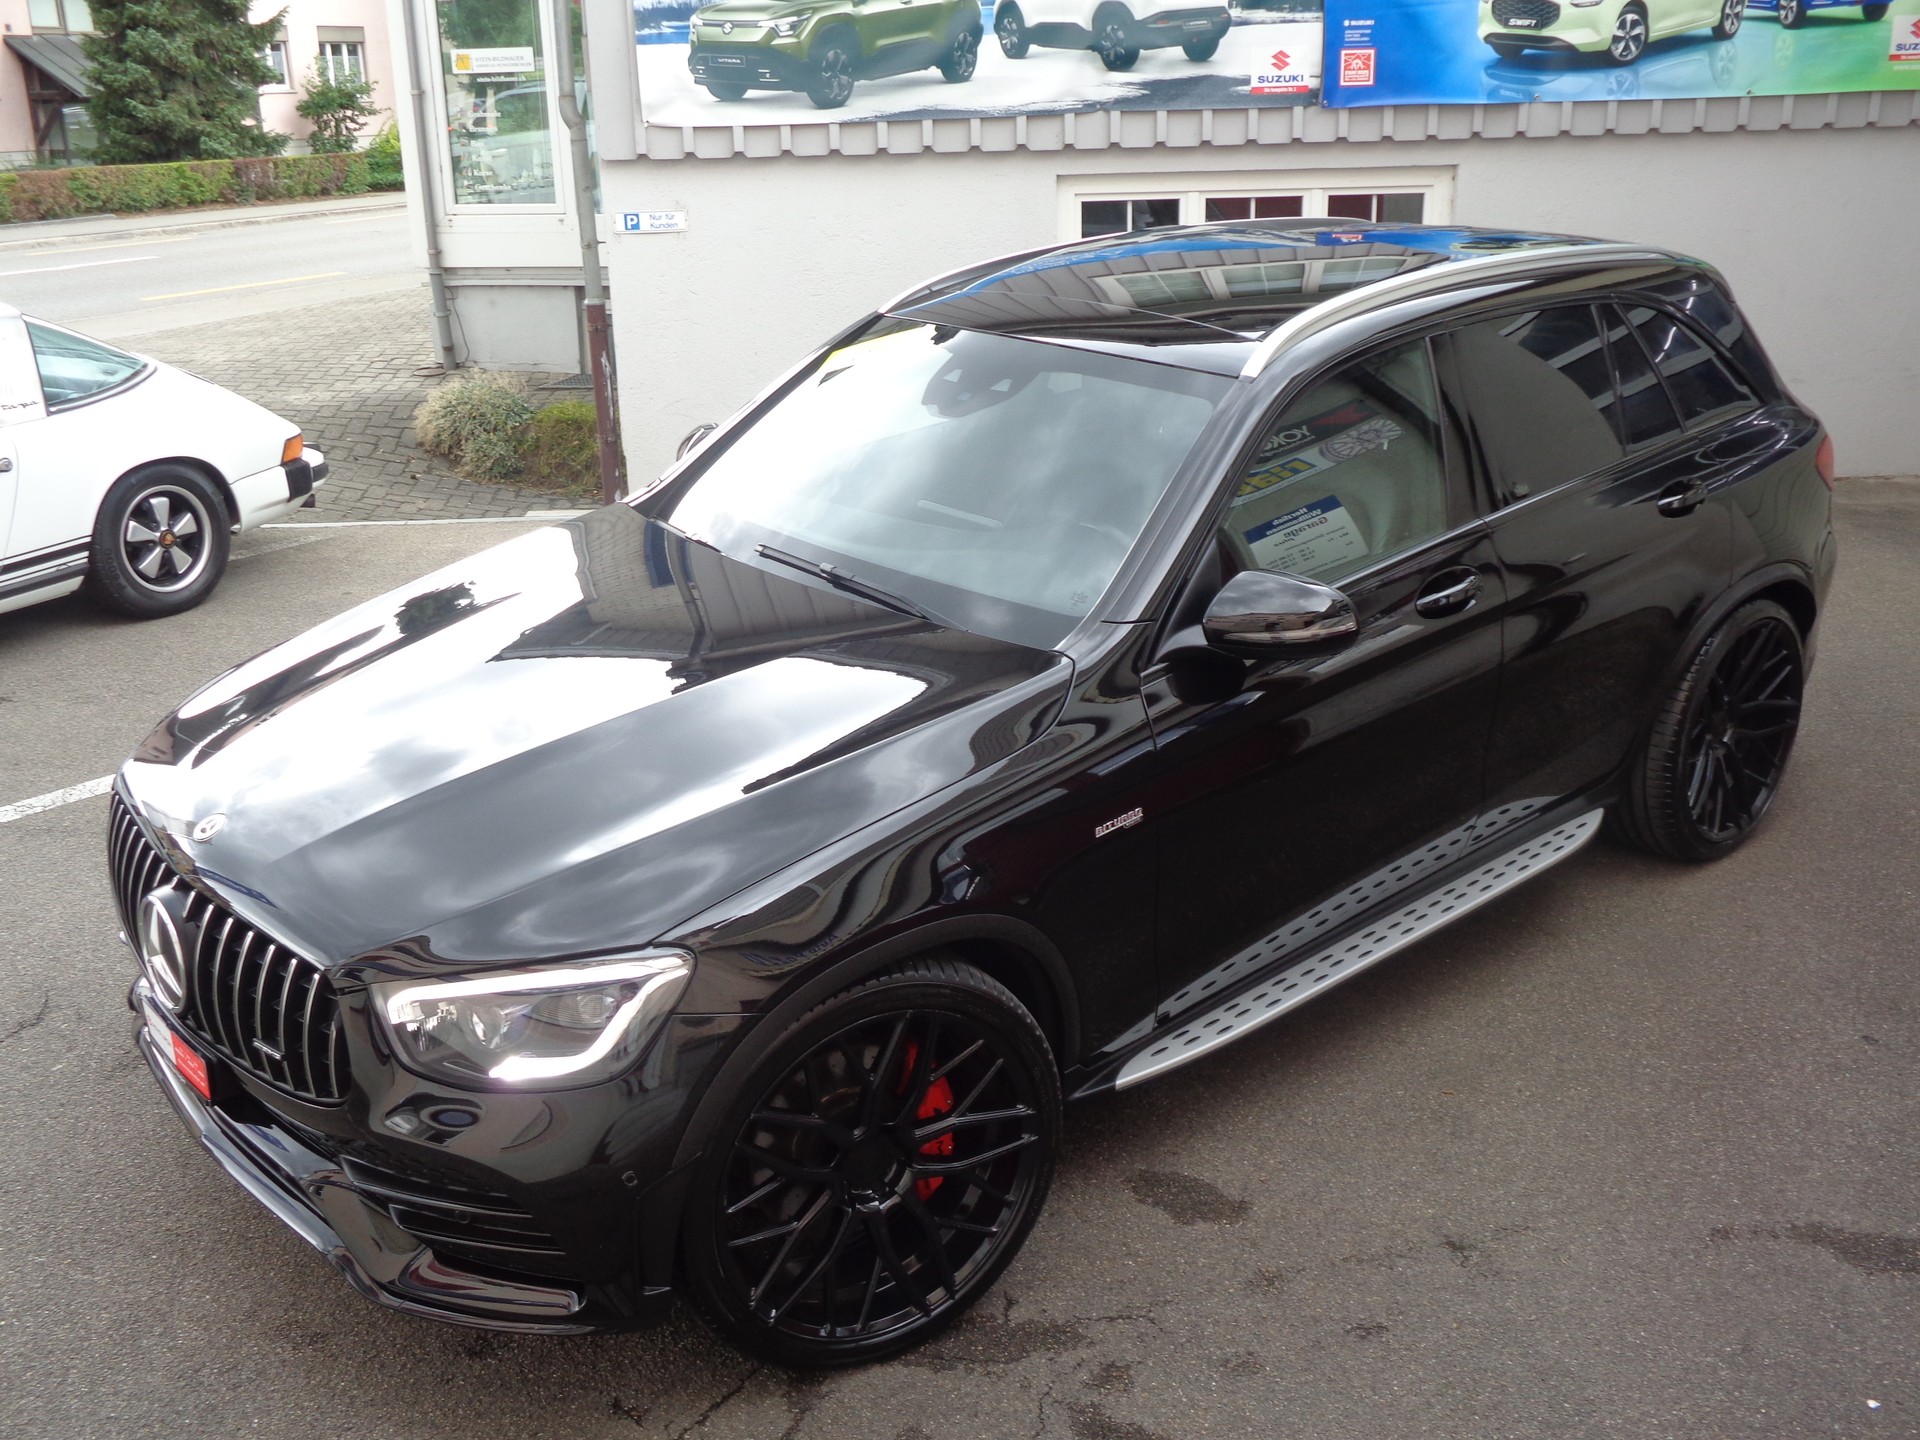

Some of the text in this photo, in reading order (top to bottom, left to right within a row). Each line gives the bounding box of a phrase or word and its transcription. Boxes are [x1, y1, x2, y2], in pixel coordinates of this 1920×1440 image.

[1508, 18, 1538, 27] SWIFT
[1257, 74, 1304, 83] SUZUKI
[626, 215, 638, 229] P
[1095, 807, 1143, 838] BITURBO
